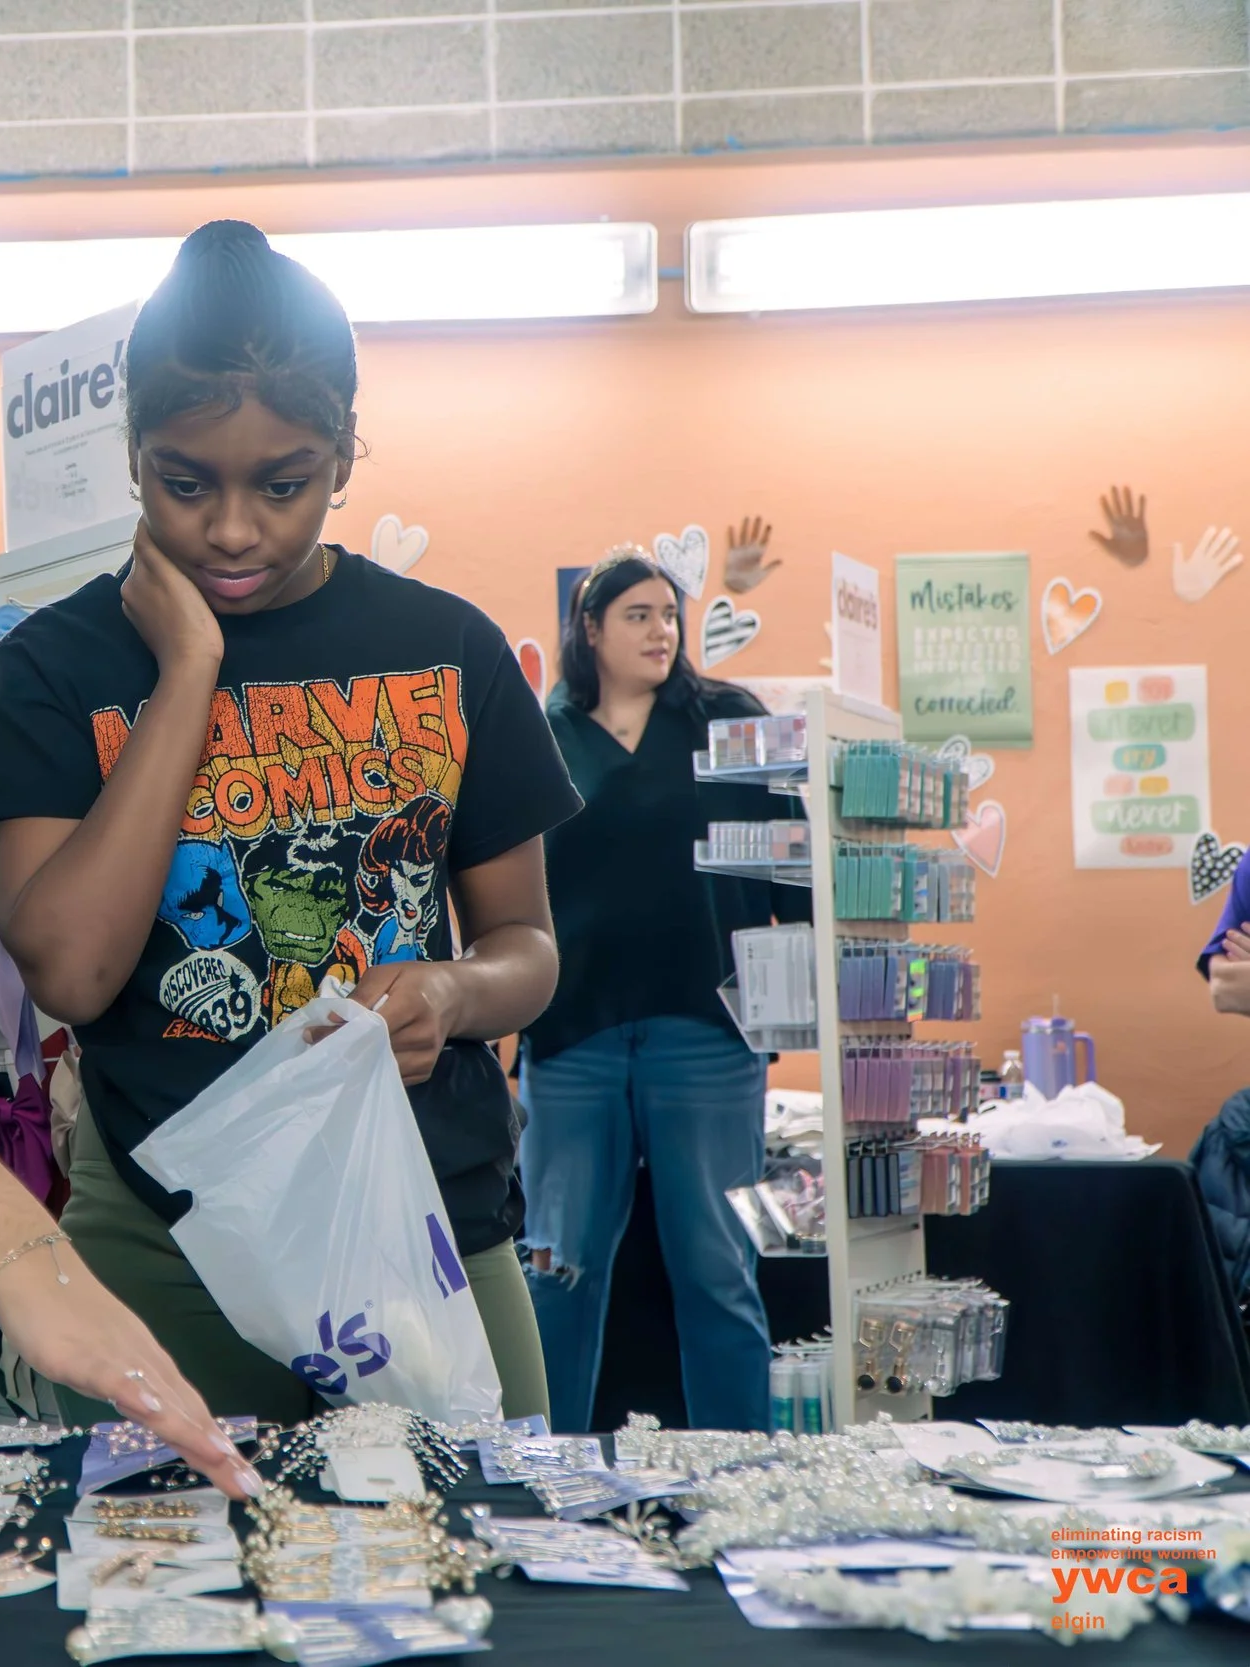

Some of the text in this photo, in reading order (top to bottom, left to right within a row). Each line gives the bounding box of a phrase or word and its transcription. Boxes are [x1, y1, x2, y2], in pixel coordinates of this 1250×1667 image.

[910, 578, 1019, 614] Mistakes
[181, 747, 428, 837] COMICS
[1106, 801, 1188, 829] never
[162, 956, 228, 1010] DISCOVERED
